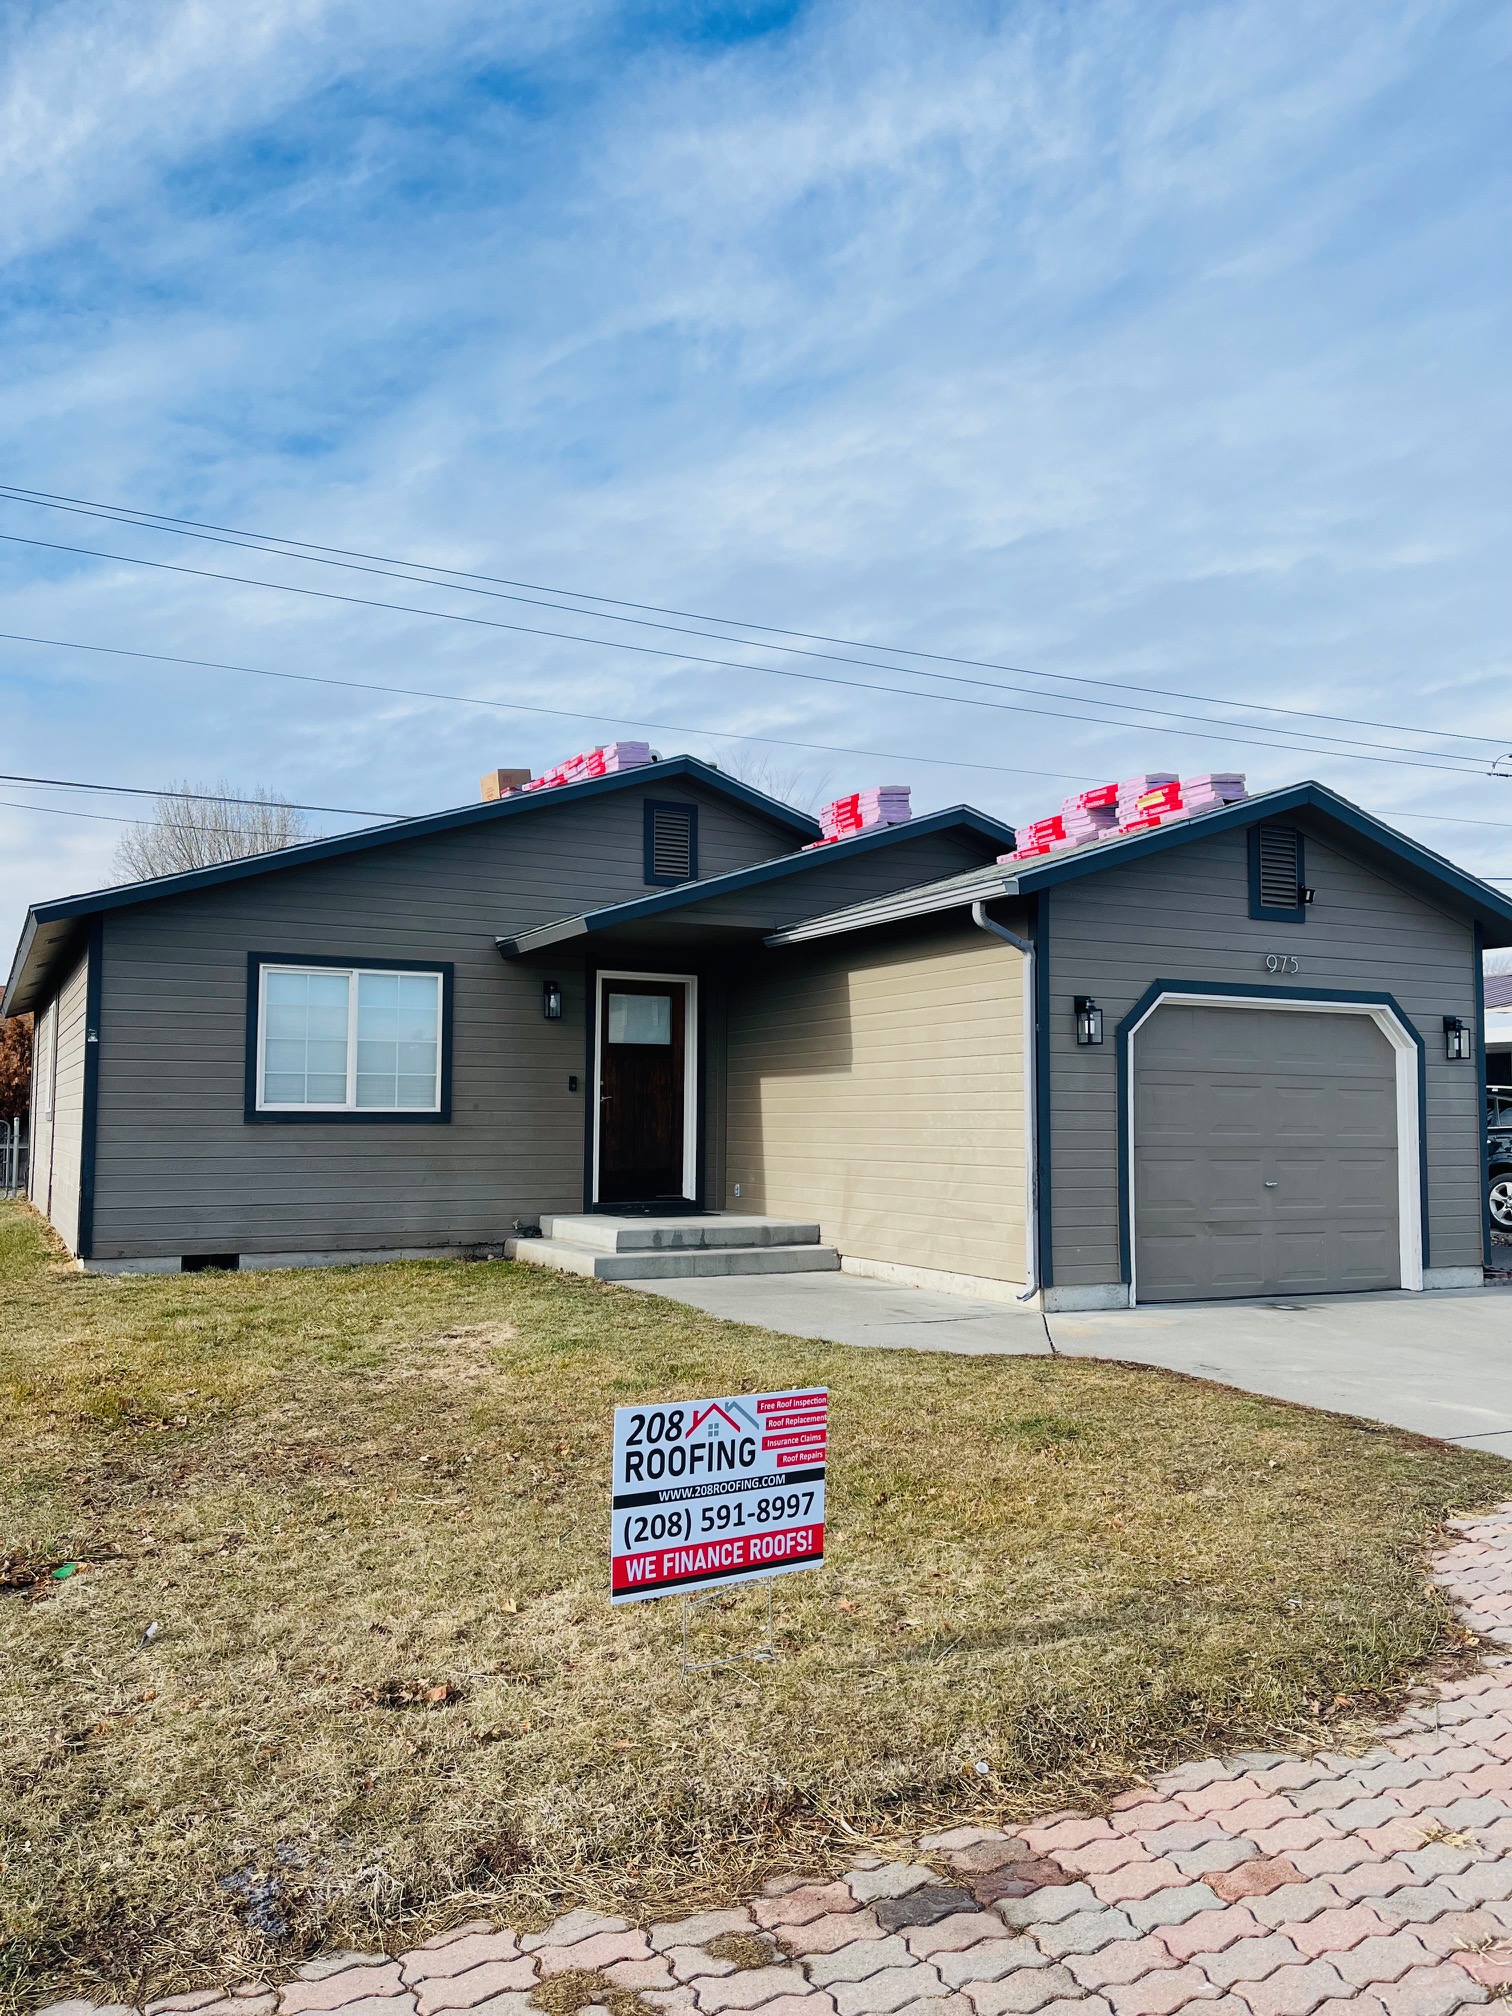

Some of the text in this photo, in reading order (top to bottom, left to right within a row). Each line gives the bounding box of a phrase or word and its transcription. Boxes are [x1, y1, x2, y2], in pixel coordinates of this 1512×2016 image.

[1148, 804, 1171, 814] OAKRIDGE
[1266, 954, 1299, 974] 975
[760, 1396, 827, 1411] Free Roof Inspection
[625, 1410, 684, 1447] 208
[768, 1414, 827, 1428] Roof Replacement
[767, 1434, 822, 1448] Insurance Claims
[625, 1437, 756, 1483] ROOFING
[782, 1450, 823, 1463] Roof Repairs
[658, 1474, 786, 1502] WWW.208ROOFING.COM
[624, 1491, 815, 1550] (208) 591-8997
[625, 1529, 813, 1582] WE FINANCE ROOFS!
